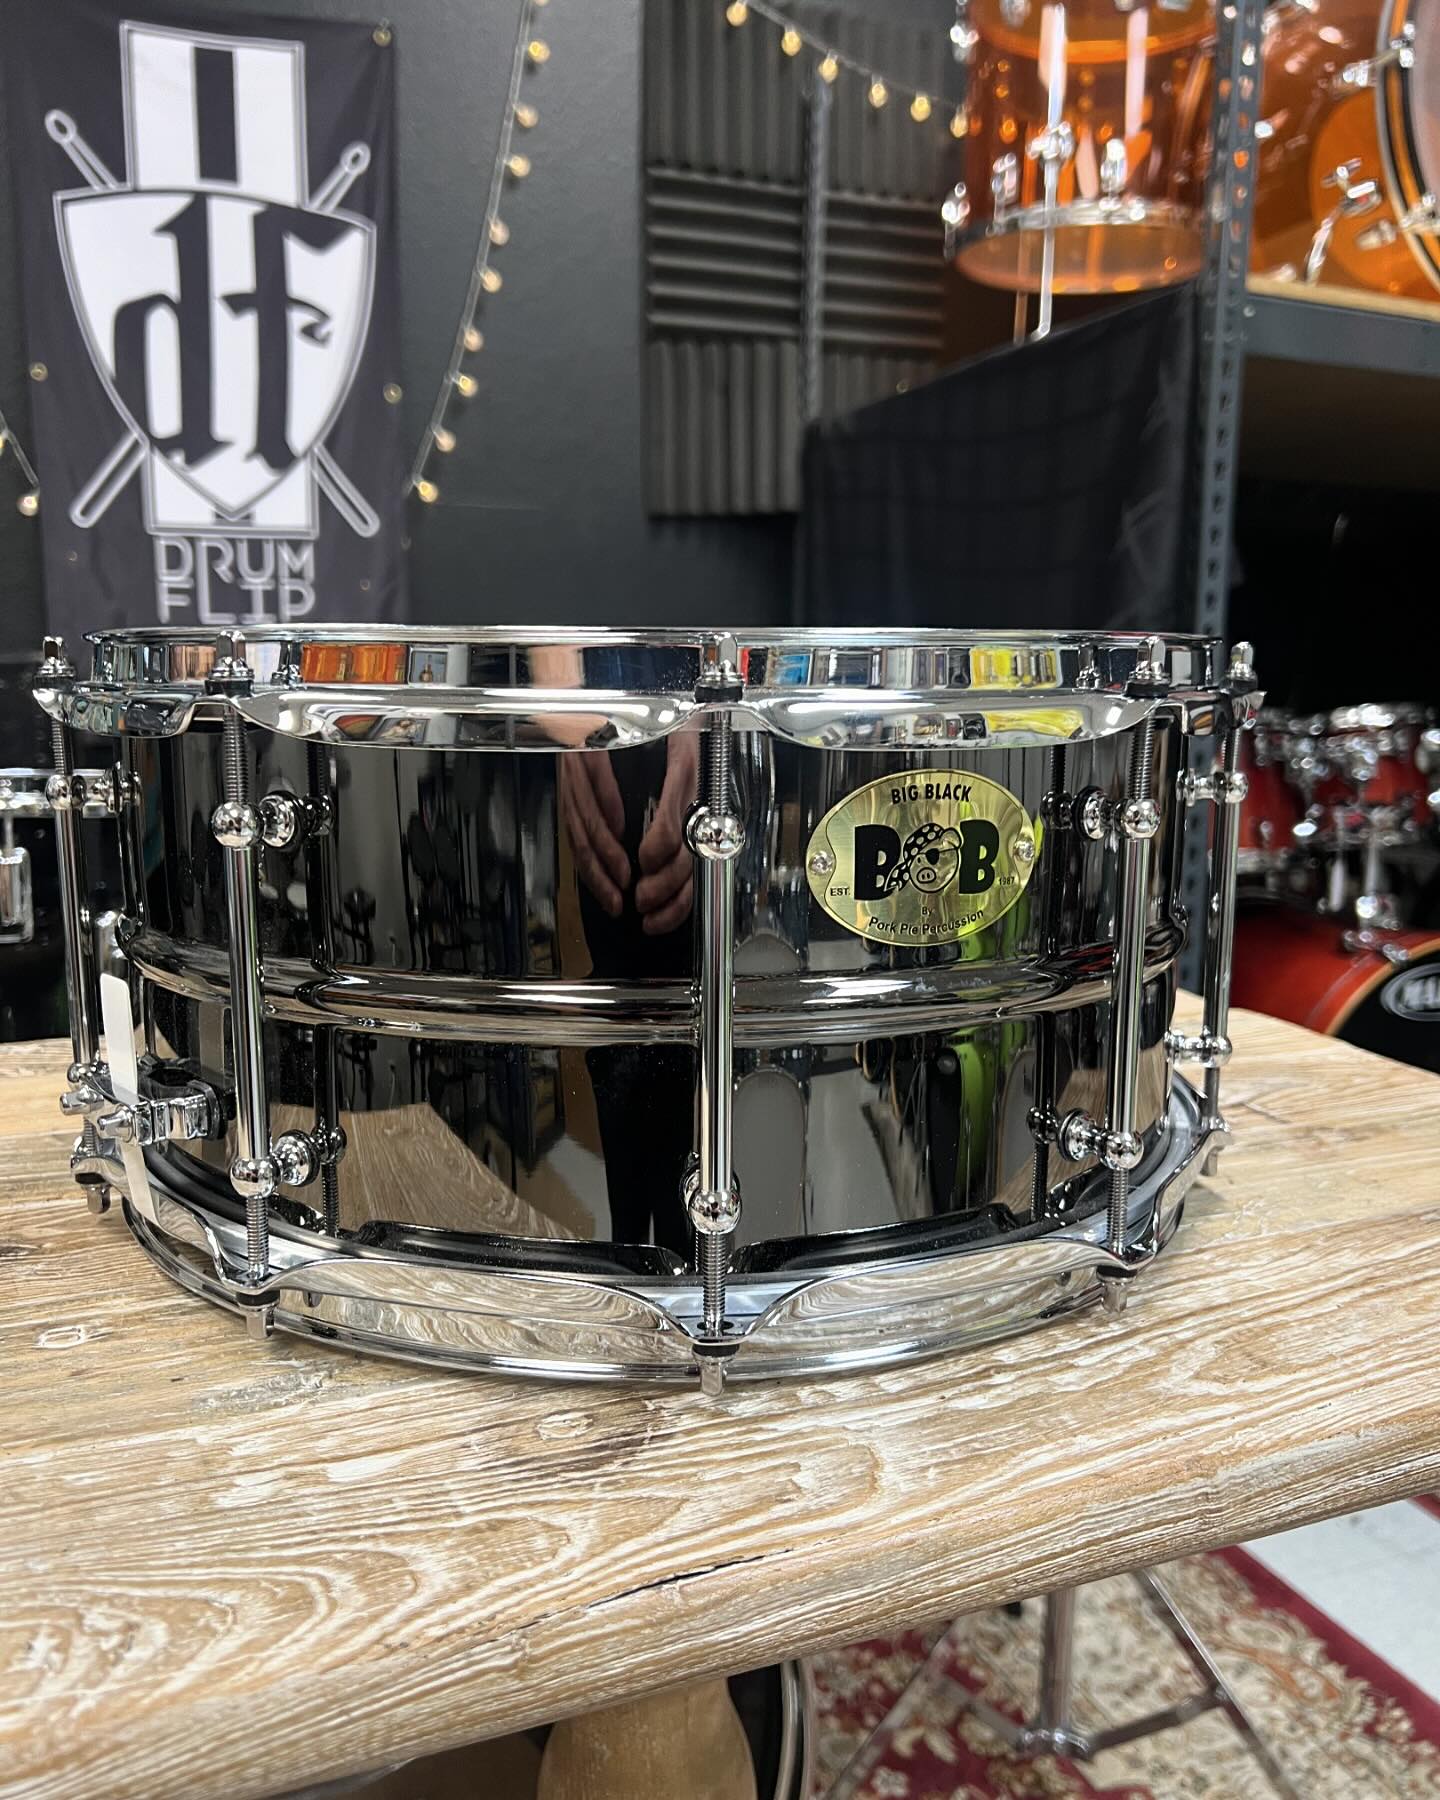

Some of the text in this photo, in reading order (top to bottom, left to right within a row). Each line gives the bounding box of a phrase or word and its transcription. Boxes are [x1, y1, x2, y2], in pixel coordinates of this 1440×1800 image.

[153, 537, 315, 583] DRUM
[156, 578, 316, 624] FLIP
[891, 783, 972, 804] BIG BLACK
[830, 887, 851, 897] EST.
[868, 909, 984, 935] Pork Pie Percussion
[921, 906, 933, 917] By
